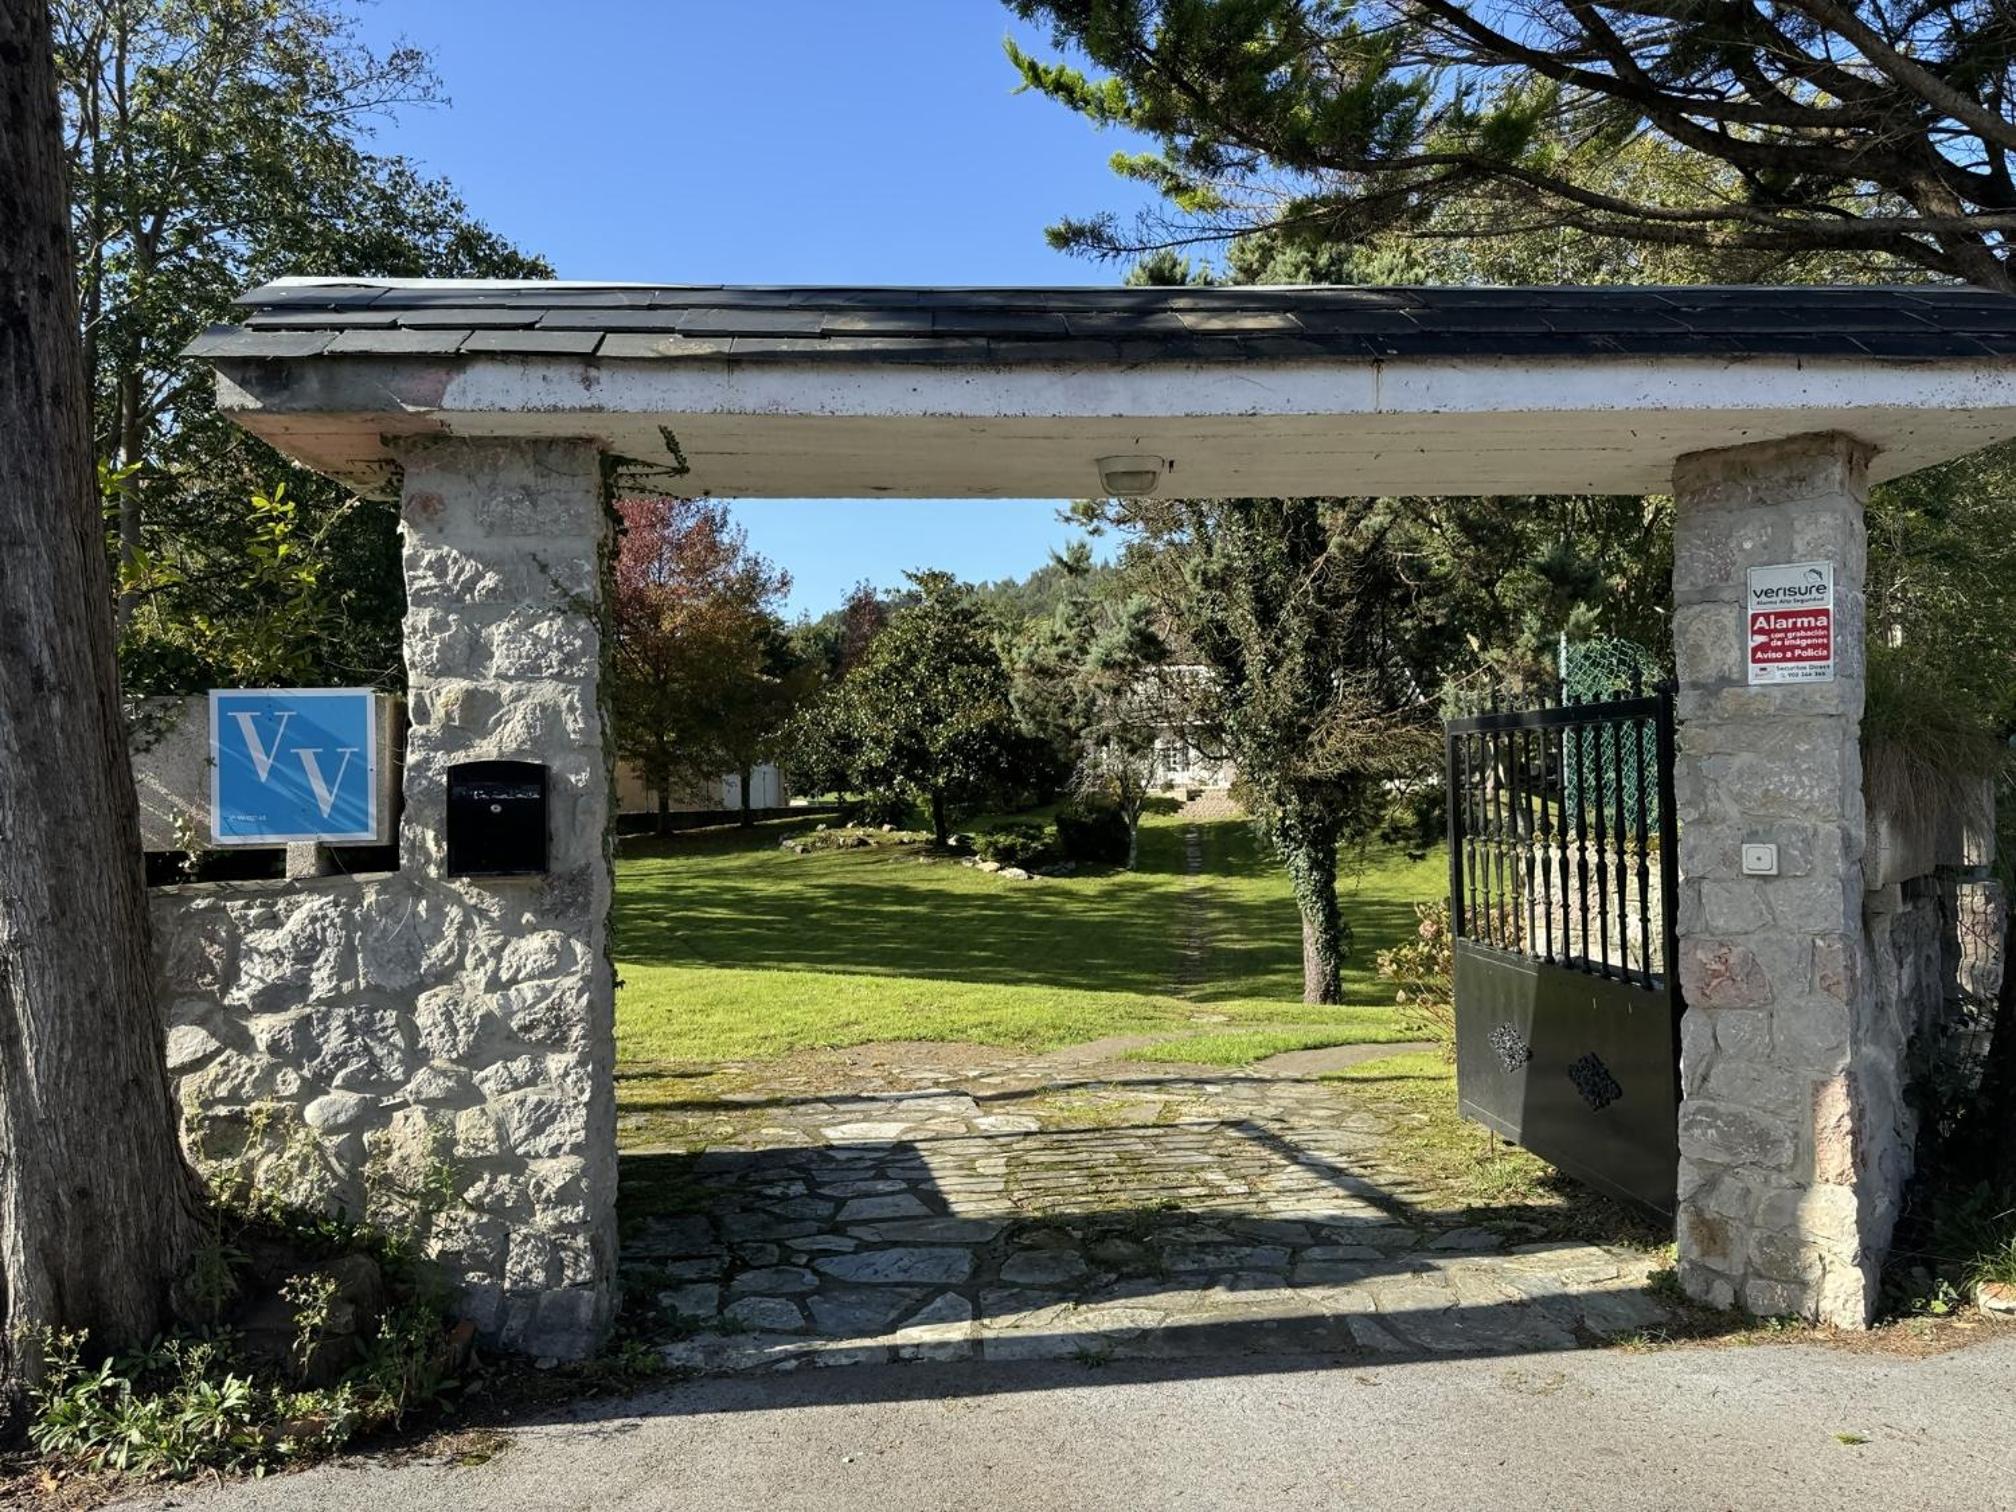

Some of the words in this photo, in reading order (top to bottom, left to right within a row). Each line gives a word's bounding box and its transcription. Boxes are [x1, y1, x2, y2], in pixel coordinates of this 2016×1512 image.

[1752, 584, 1827, 598] verisure
[1753, 615, 1828, 630] Alarma
[1787, 629, 1828, 639] grabación
[1784, 637, 1828, 647] imágenes
[1755, 650, 1783, 659] Aviso
[1794, 648, 1828, 657] Policía
